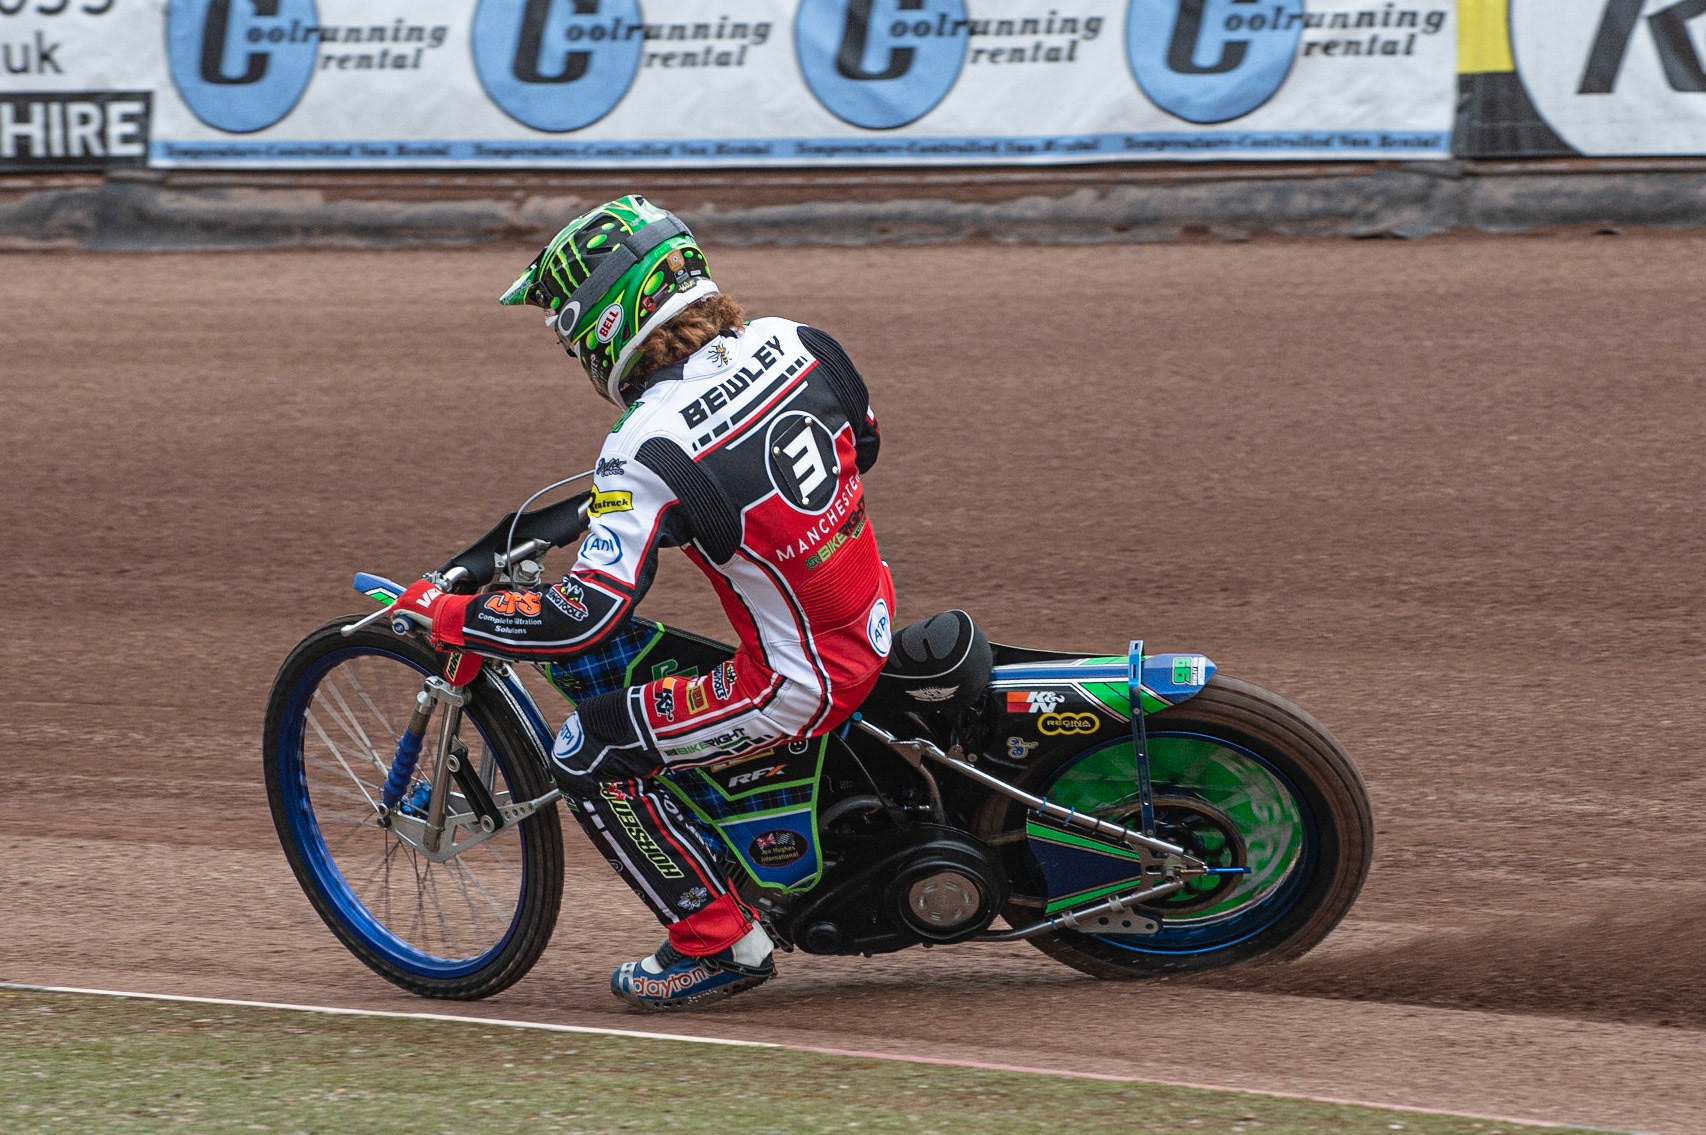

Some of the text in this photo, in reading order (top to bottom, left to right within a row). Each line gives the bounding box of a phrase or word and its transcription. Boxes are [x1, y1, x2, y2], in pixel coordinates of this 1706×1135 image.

[644, 46, 749, 67] rental
[970, 40, 1078, 64] rental
[1303, 33, 1417, 57] rental
[319, 49, 424, 70] rental
[0, 101, 146, 158] HIRE
[598, 310, 619, 338] BELL
[678, 335, 785, 430] BEWLEY
[782, 425, 828, 499] 3
[1026, 690, 1066, 714] K&N
[727, 763, 789, 788] RFX
[632, 966, 724, 999] dayton
